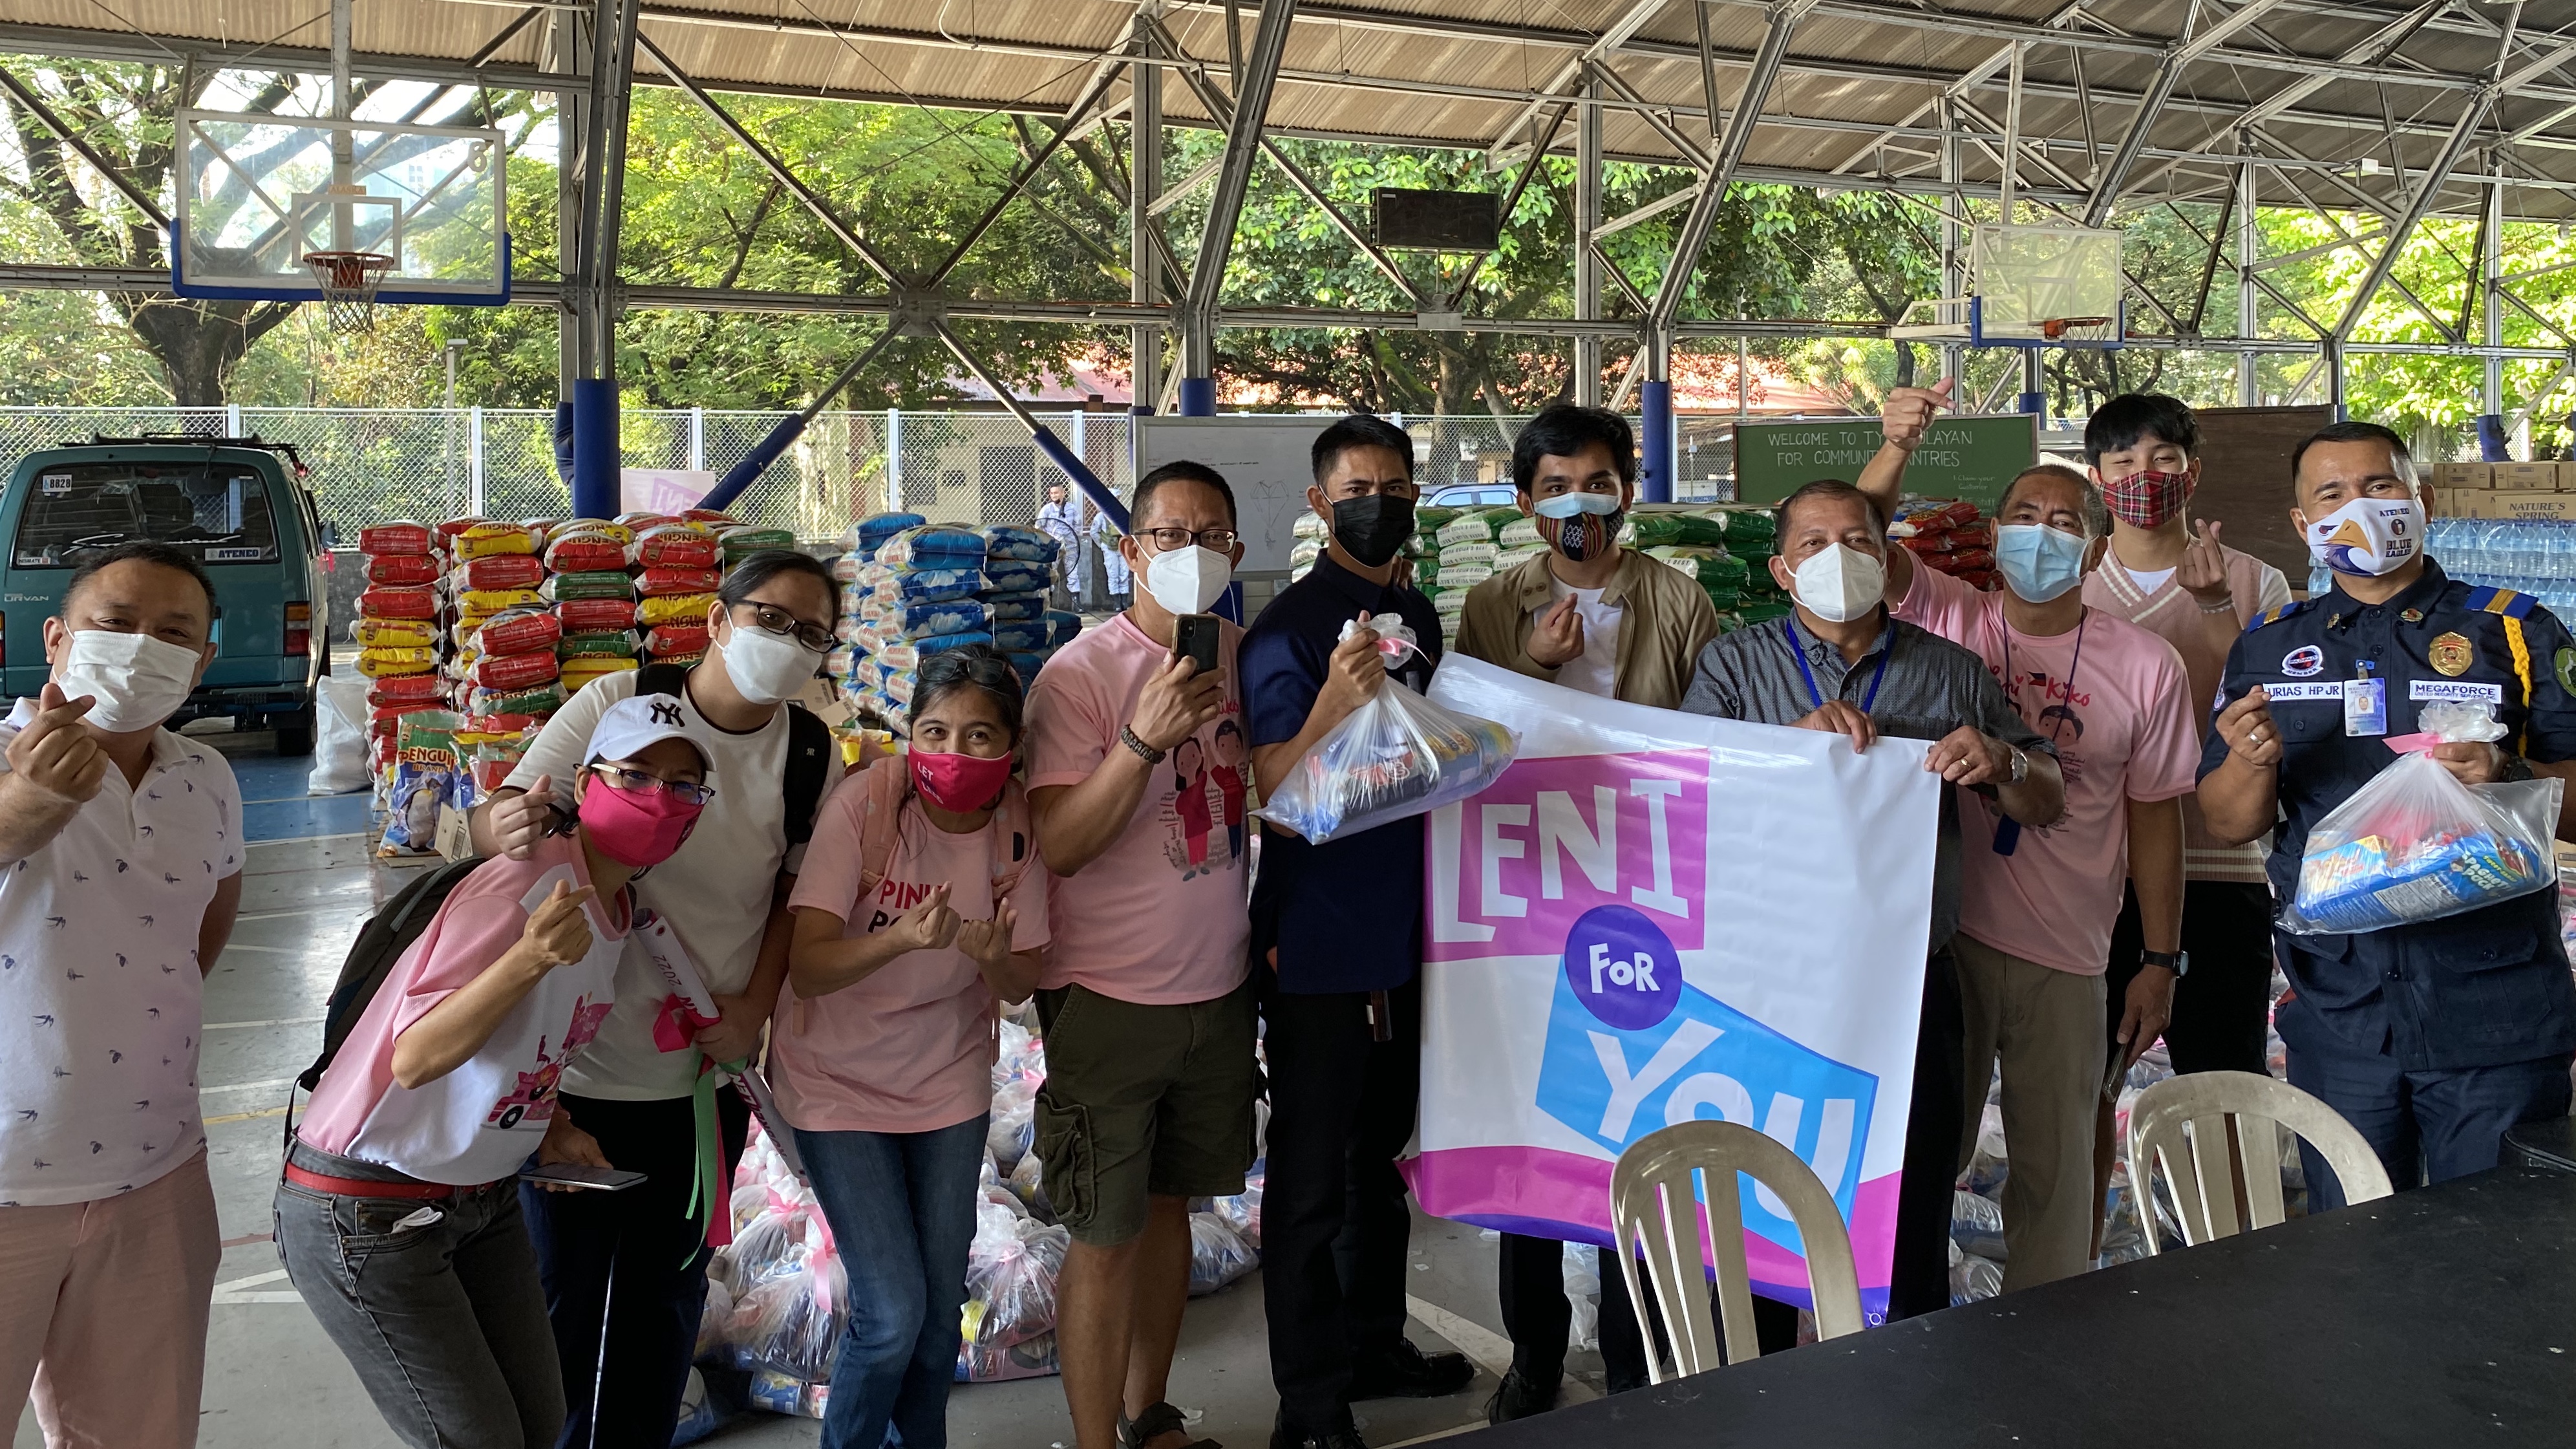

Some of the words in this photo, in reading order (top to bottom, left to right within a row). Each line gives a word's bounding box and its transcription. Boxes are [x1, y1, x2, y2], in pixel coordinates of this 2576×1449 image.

[467, 141, 487, 173] 6
[330, 184, 365, 194] ALASKA
[1768, 433, 1829, 446] WELCOME
[1839, 431, 1857, 445] TO
[1777, 452, 1803, 467] FOR
[1814, 450, 1879, 466] COMMUNIT
[2379, 508, 2410, 517] ATENEO
[2509, 502, 2566, 511] NATURE'S
[2515, 511, 2560, 520] SPRING
[2386, 539, 2412, 550] BLUE
[218, 549, 259, 558] ATENEO
[2385, 549, 2412, 557] EAGLES
[2045, 676, 2091, 707] Kiko
[2308, 685, 2324, 695] HP
[2325, 685, 2339, 696] JR
[2415, 684, 2496, 696] MEGAFORCE
[650, 702, 685, 727] NY
[412, 762, 445, 773] BRAND
[917, 760, 934, 781] LET
[1432, 778, 1689, 943] LENI
[652, 954, 683, 986] 2022
[1588, 942, 1661, 994] FOR
